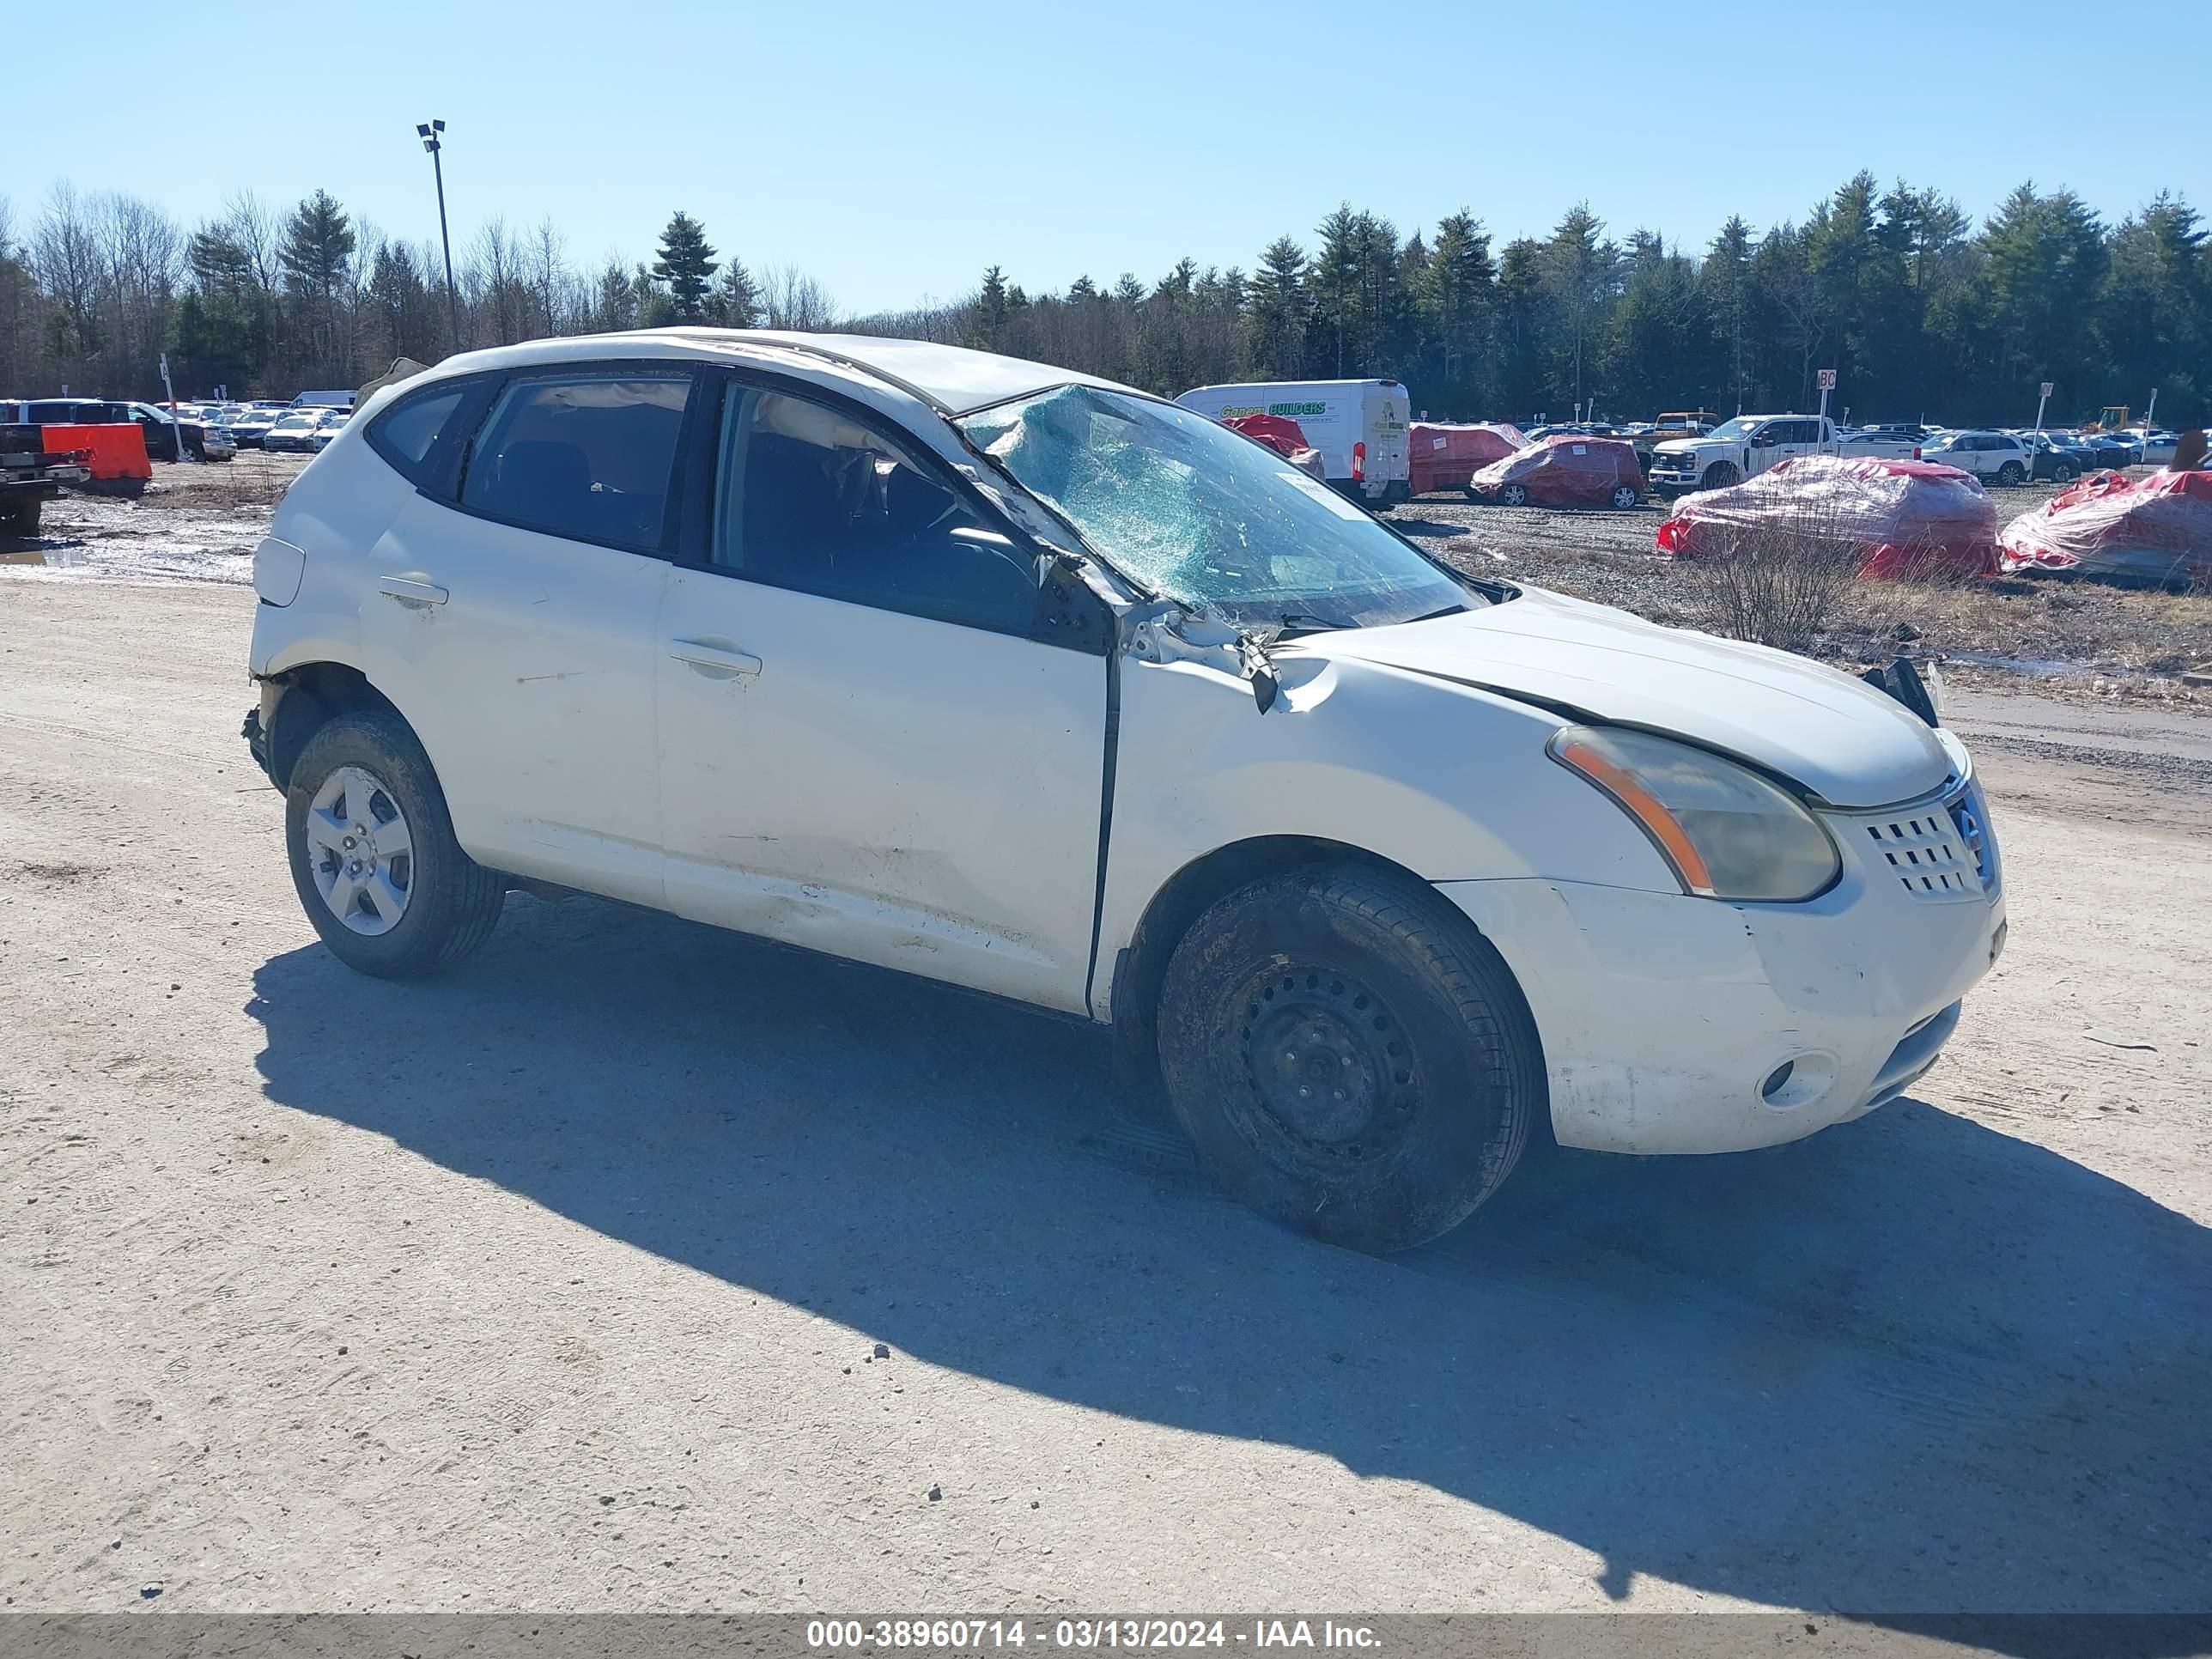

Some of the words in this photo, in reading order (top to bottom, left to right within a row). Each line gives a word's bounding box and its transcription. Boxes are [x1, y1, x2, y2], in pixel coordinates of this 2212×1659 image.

[1820, 373, 1836, 386] BC
[1220, 405, 1265, 417] Ganem
[1269, 402, 1327, 416] BUILDERS
